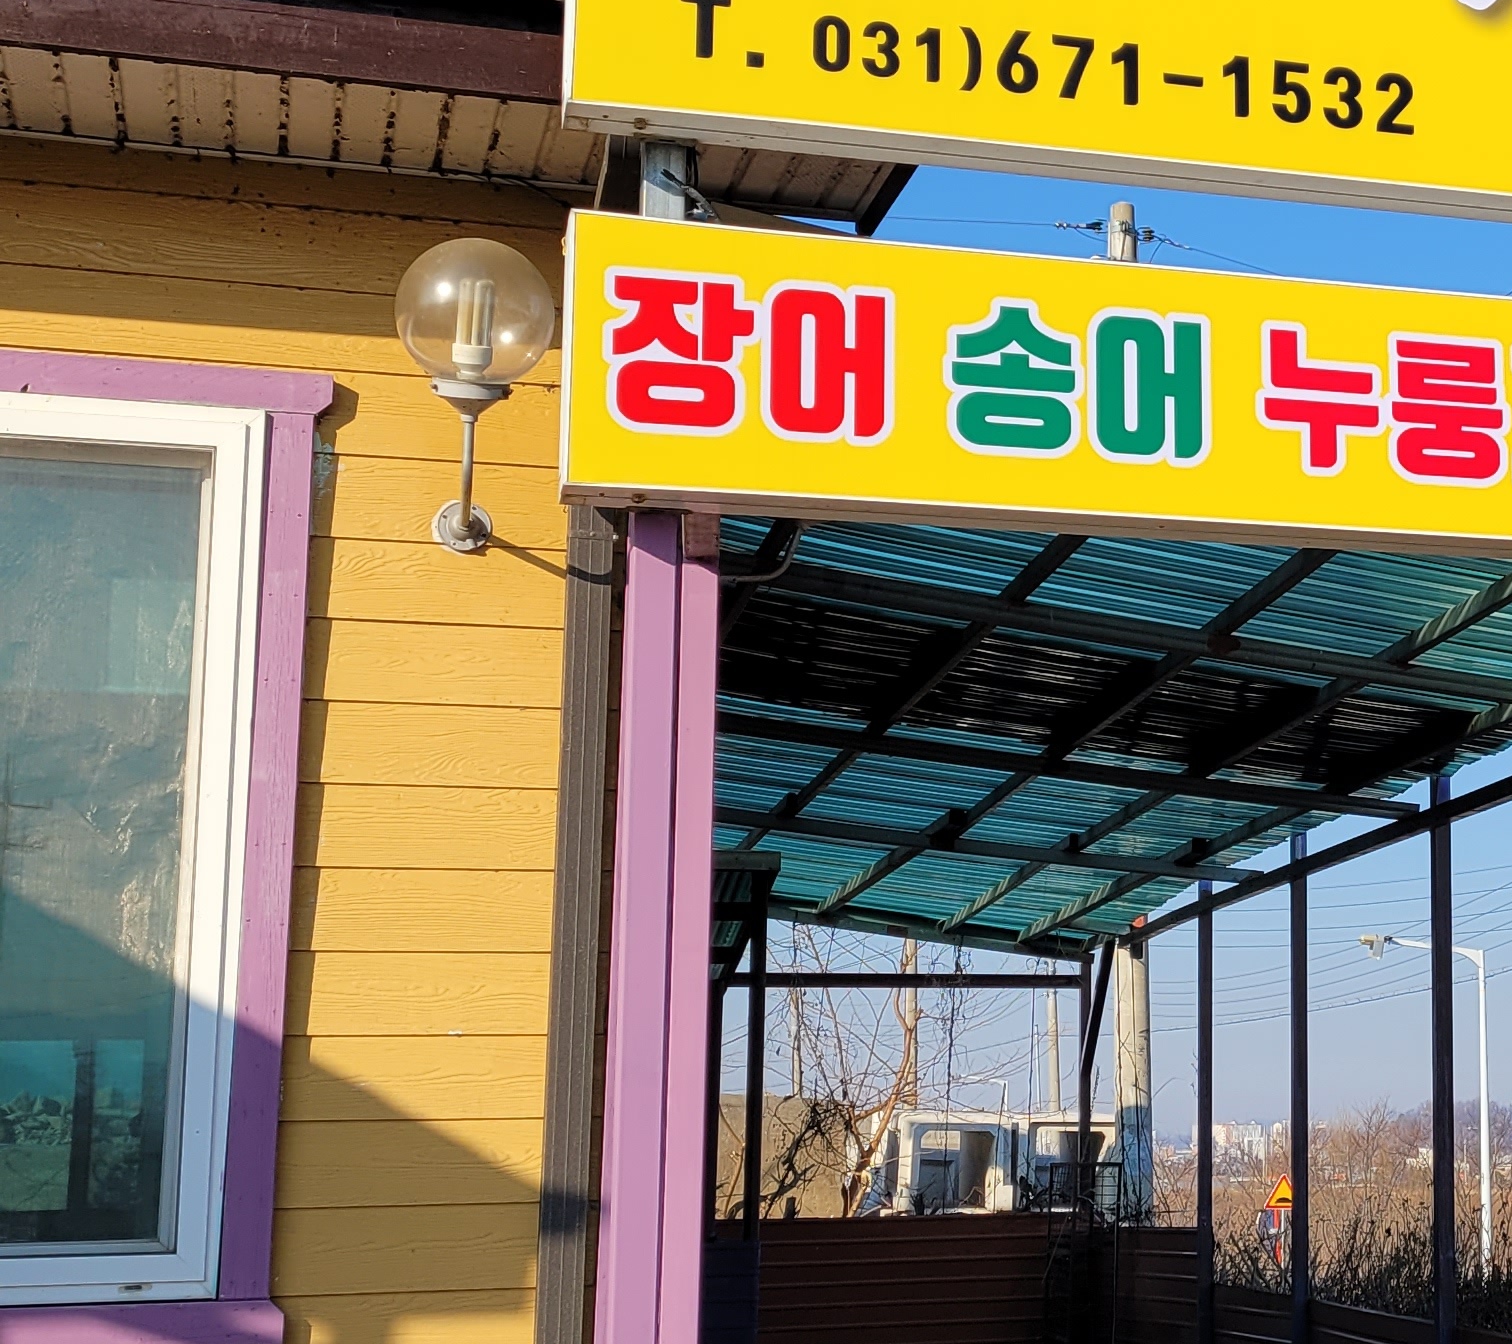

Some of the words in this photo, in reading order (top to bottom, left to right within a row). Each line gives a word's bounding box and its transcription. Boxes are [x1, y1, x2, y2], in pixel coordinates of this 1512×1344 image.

[812, 15, 1416, 136] 031)671-1532
[604, 266, 896, 444] 장어
[945, 298, 1211, 467] 송어
